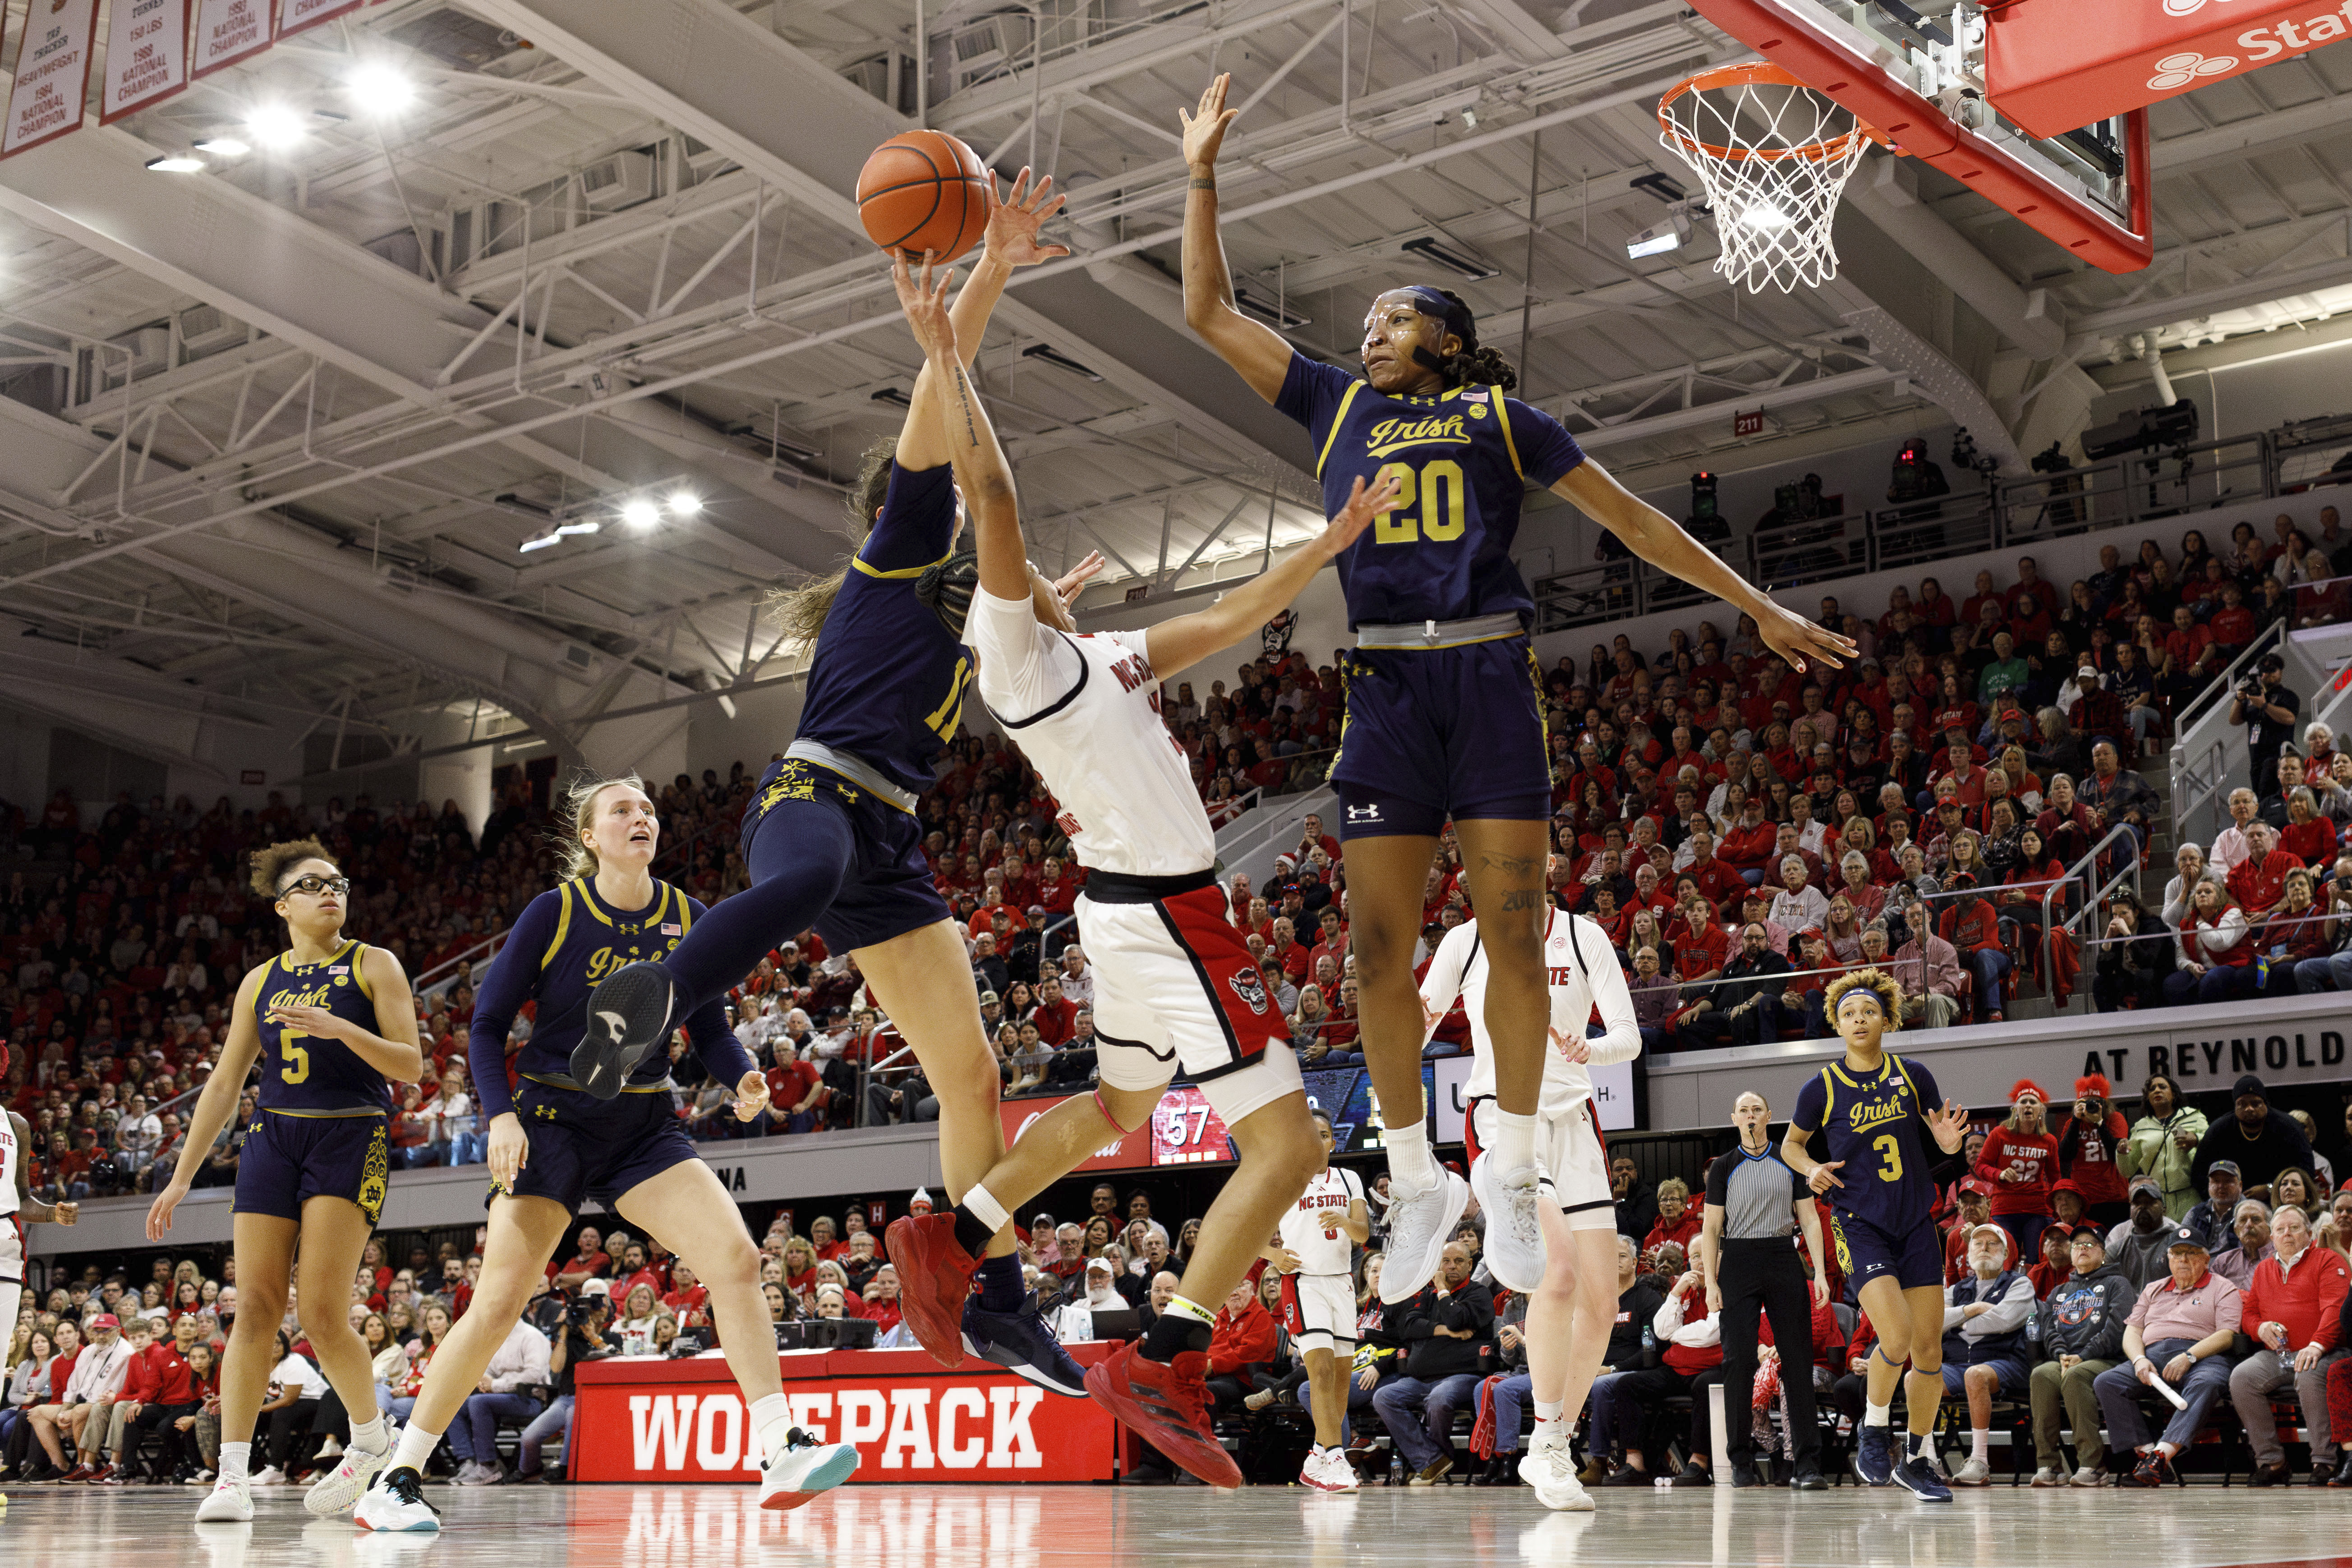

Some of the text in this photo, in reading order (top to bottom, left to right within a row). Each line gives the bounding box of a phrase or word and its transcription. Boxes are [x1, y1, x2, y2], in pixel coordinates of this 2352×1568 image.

[147, 17, 163, 35] LBS
[213, 12, 256, 38] NATIONAL
[209, 26, 258, 56] CHAMPION
[17, 51, 79, 88] HEAVYWEIGHT
[122, 52, 167, 84] NATIONAL
[118, 67, 169, 101] CHAMPION
[22, 93, 64, 122] NATIONAL
[17, 108, 67, 139] CHAMPION
[1367, 414, 1471, 448] Irish
[1738, 417, 1758, 432] 211
[1375, 459, 1465, 544] 20
[1942, 711, 1963, 720] STATE
[1689, 949, 1709, 961] STATE
[265, 984, 331, 1016] Irish
[281, 1028, 309, 1085] 5
[2083, 1048, 2128, 1081] AT
[1168, 1105, 1210, 1146] 57
[1850, 1094, 1907, 1127] Irish
[1873, 1134, 1903, 1182] 3
[2003, 1144, 2048, 1159] NC STATE
[873, 1205, 883, 1223] H
[1299, 1194, 1347, 1211] NC STATE
[2053, 1297, 2103, 1315] FINAL FOUR
